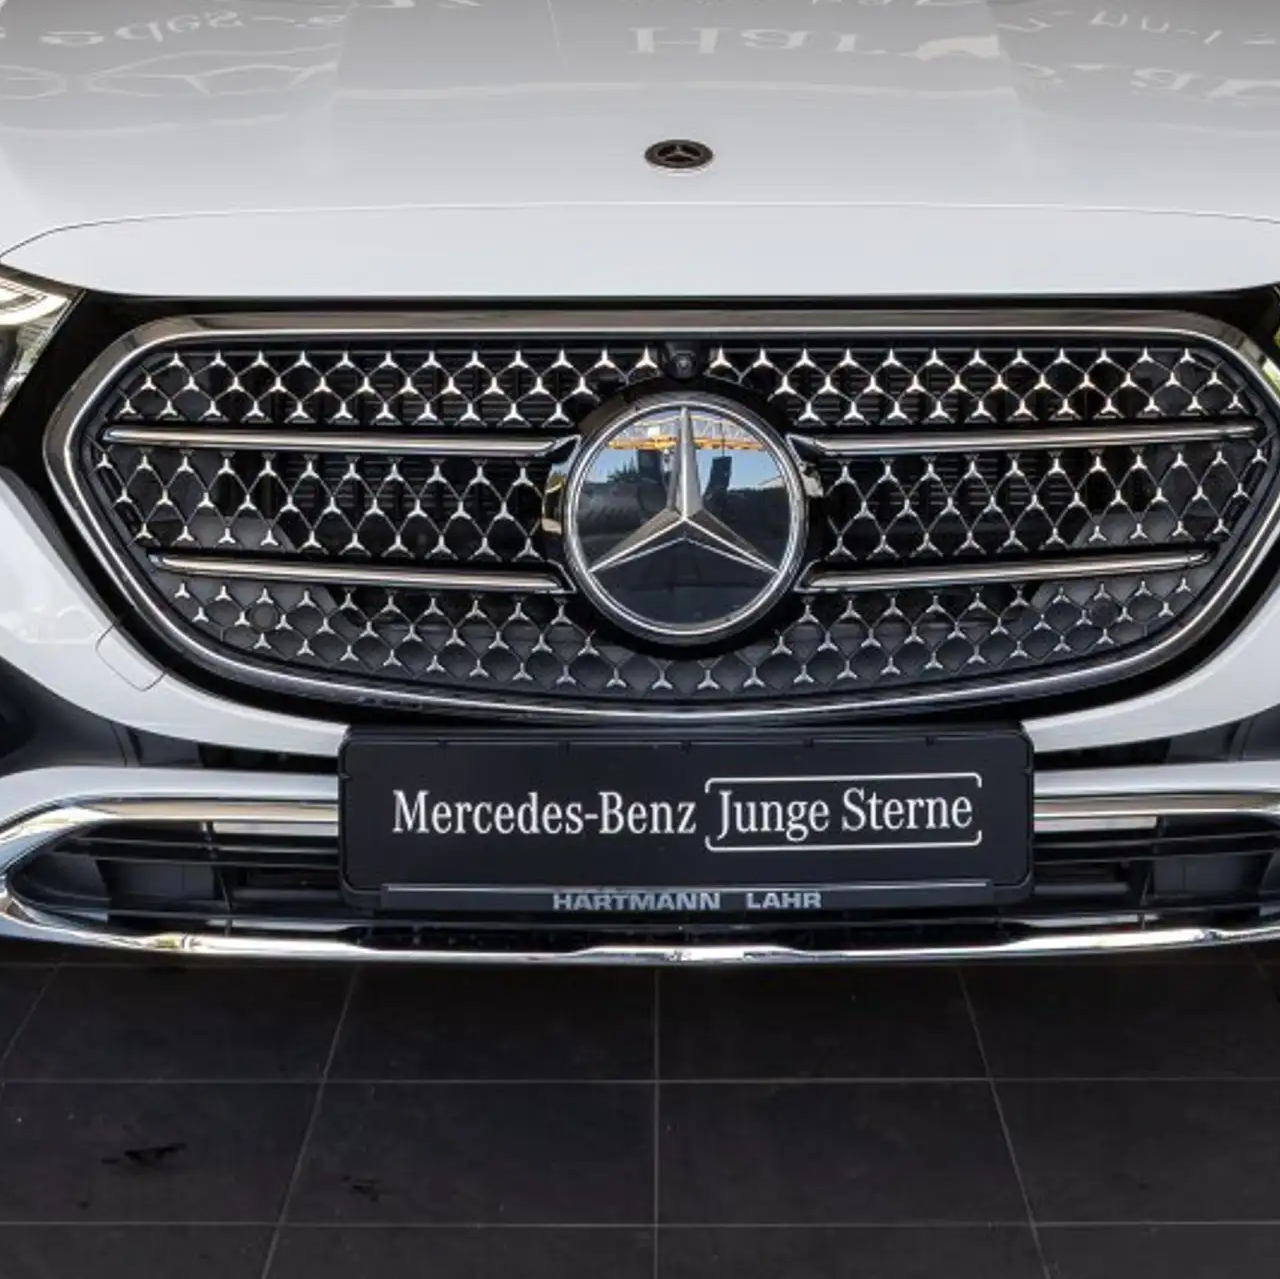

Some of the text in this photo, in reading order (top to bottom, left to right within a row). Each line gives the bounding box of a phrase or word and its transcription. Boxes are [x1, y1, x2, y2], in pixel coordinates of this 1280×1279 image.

[392, 786, 973, 842] Mercedes-Benz Junge Sterne
[552, 890, 822, 911] HARTMANN LAHR
